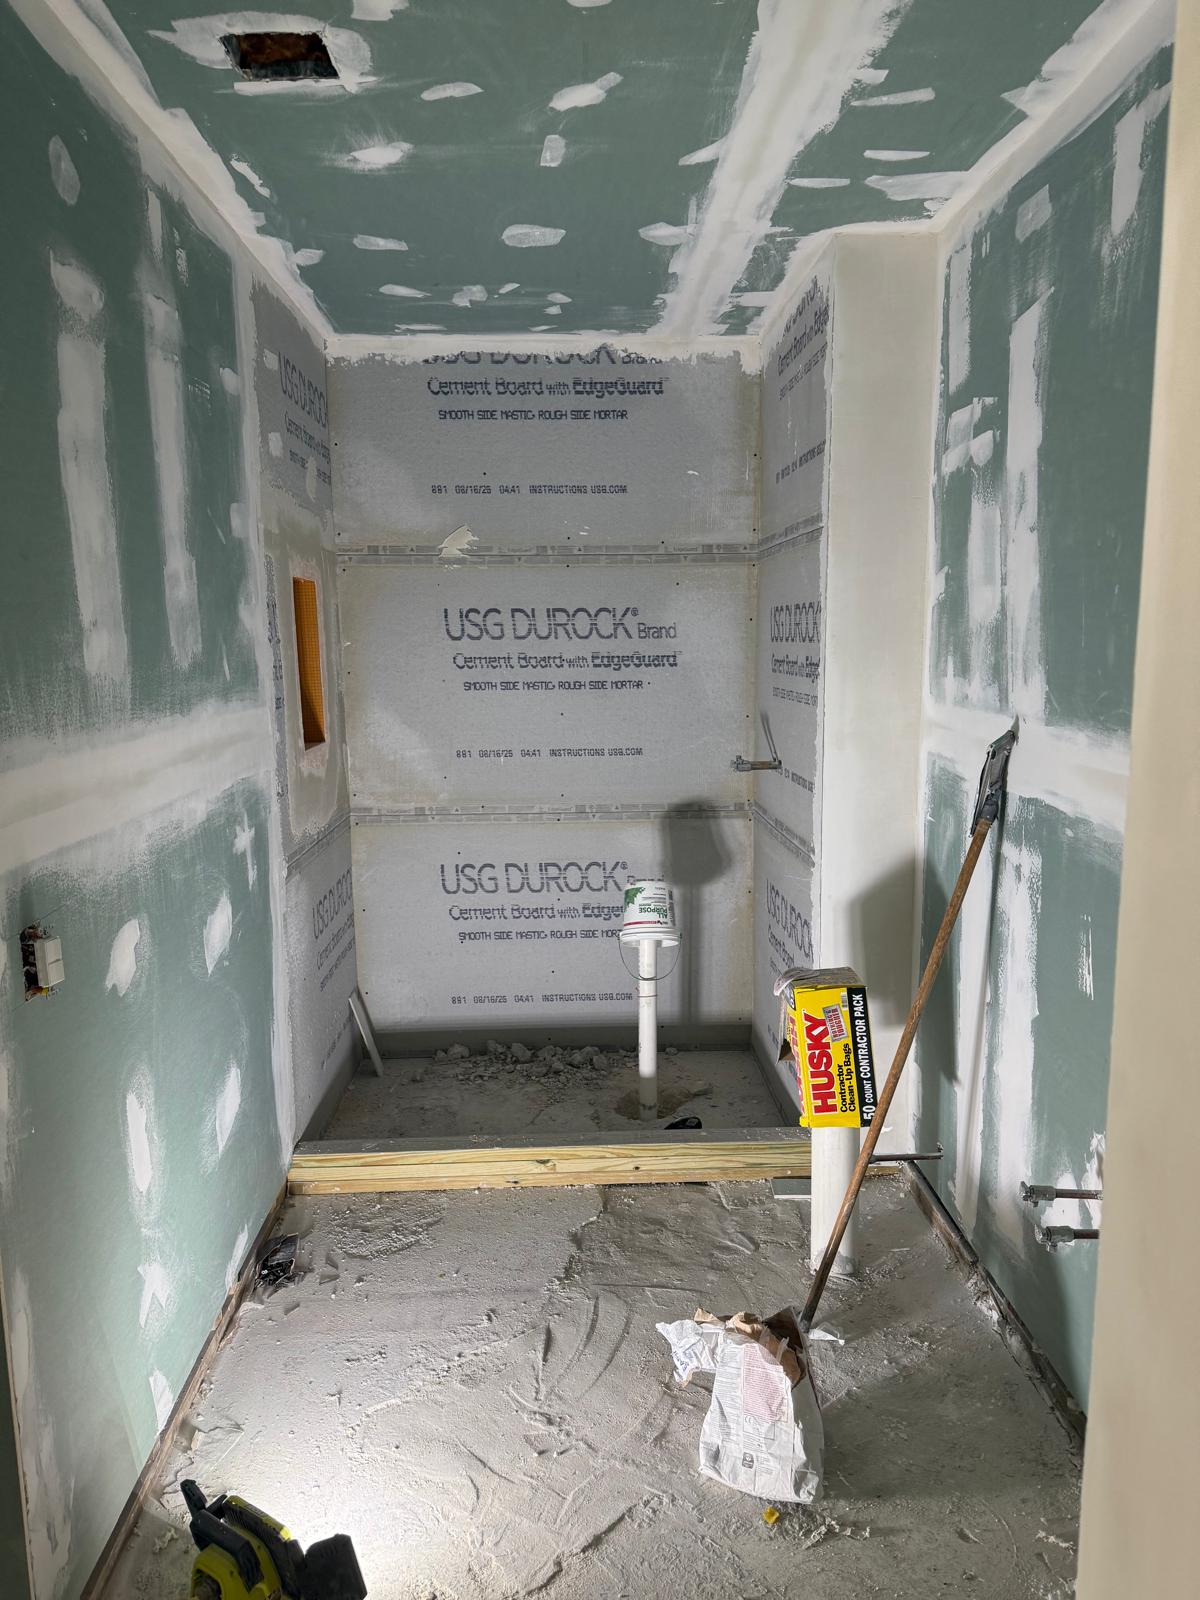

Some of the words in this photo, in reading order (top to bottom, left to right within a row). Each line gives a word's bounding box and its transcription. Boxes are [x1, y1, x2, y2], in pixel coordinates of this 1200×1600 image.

[427, 376, 492, 395] Cement
[495, 377, 544, 395] Board
[546, 381, 571, 395] with
[438, 409, 474, 420] SMOOTH
[476, 409, 498, 420] SIDE
[538, 409, 567, 420] ROUGH
[570, 409, 591, 420] SIDE
[593, 409, 629, 420] MORTAR
[528, 484, 587, 494] INSTRUCTIONS
[590, 484, 628, 494] USG.COM
[443, 607, 505, 640] USG
[637, 622, 677, 640] Brand
[770, 604, 784, 642] USG
[452, 652, 514, 669] Cement
[517, 652, 564, 669] Board
[566, 655, 589, 669] with
[463, 681, 497, 691] SMOOTH
[499, 681, 521, 691] SIDE
[558, 680, 586, 690] ROUGH
[588, 680, 608, 690] SIDE
[610, 680, 643, 690] MORTAR
[549, 748, 605, 757] INSTRUCTIONS
[607, 747, 643, 756] USG.COM
[440, 863, 499, 894] USG
[448, 905, 508, 920] Cement
[511, 904, 556, 919] Board
[557, 906, 581, 919] with
[638, 906, 668, 914] PURPOSE
[458, 931, 491, 941] SMOOTH
[493, 931, 513, 940] SIDE
[550, 930, 578, 939] ROUGH
[580, 929, 599, 939] SIDE
[541, 993, 596, 1002] INSTRUCTIONS
[598, 992, 633, 1001] USG.COM
[852, 993, 865, 1017] PACK
[843, 1043, 854, 1066] Bags
[854, 1019, 872, 1079] CONTRACTOR
[803, 1011, 838, 1114] HUSKY
[836, 1063, 848, 1113] Contractor
[864, 1079, 873, 1102] COUNT
[863, 1105, 876, 1120] 50
